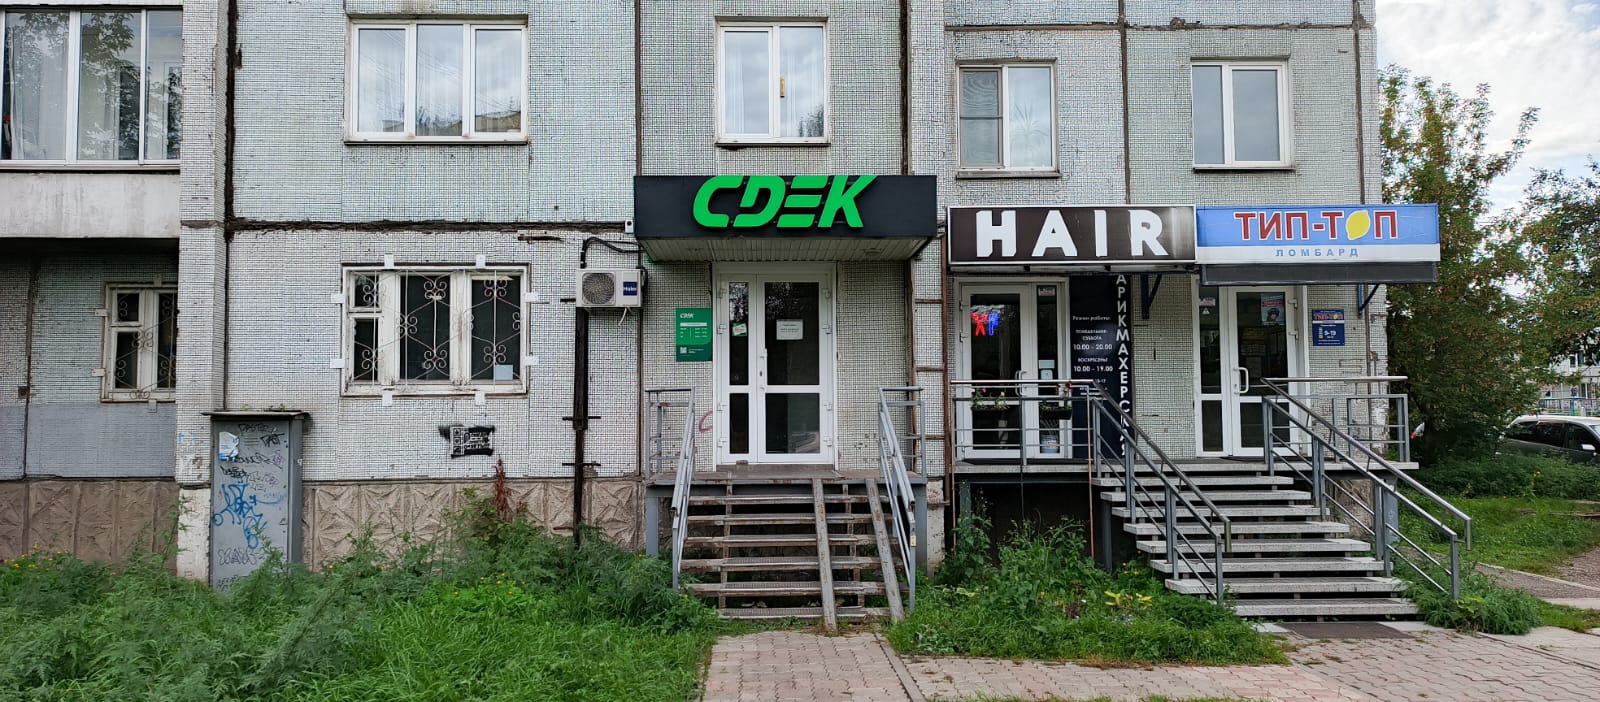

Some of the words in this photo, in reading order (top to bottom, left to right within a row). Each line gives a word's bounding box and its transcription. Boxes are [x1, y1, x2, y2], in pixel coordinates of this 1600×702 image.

[693, 175, 877, 228] CDEK
[976, 209, 1168, 257] HAIR
[1233, 209, 1398, 241] ТИП-ТОП
[1275, 248, 1359, 258] ЛОМБАРД
